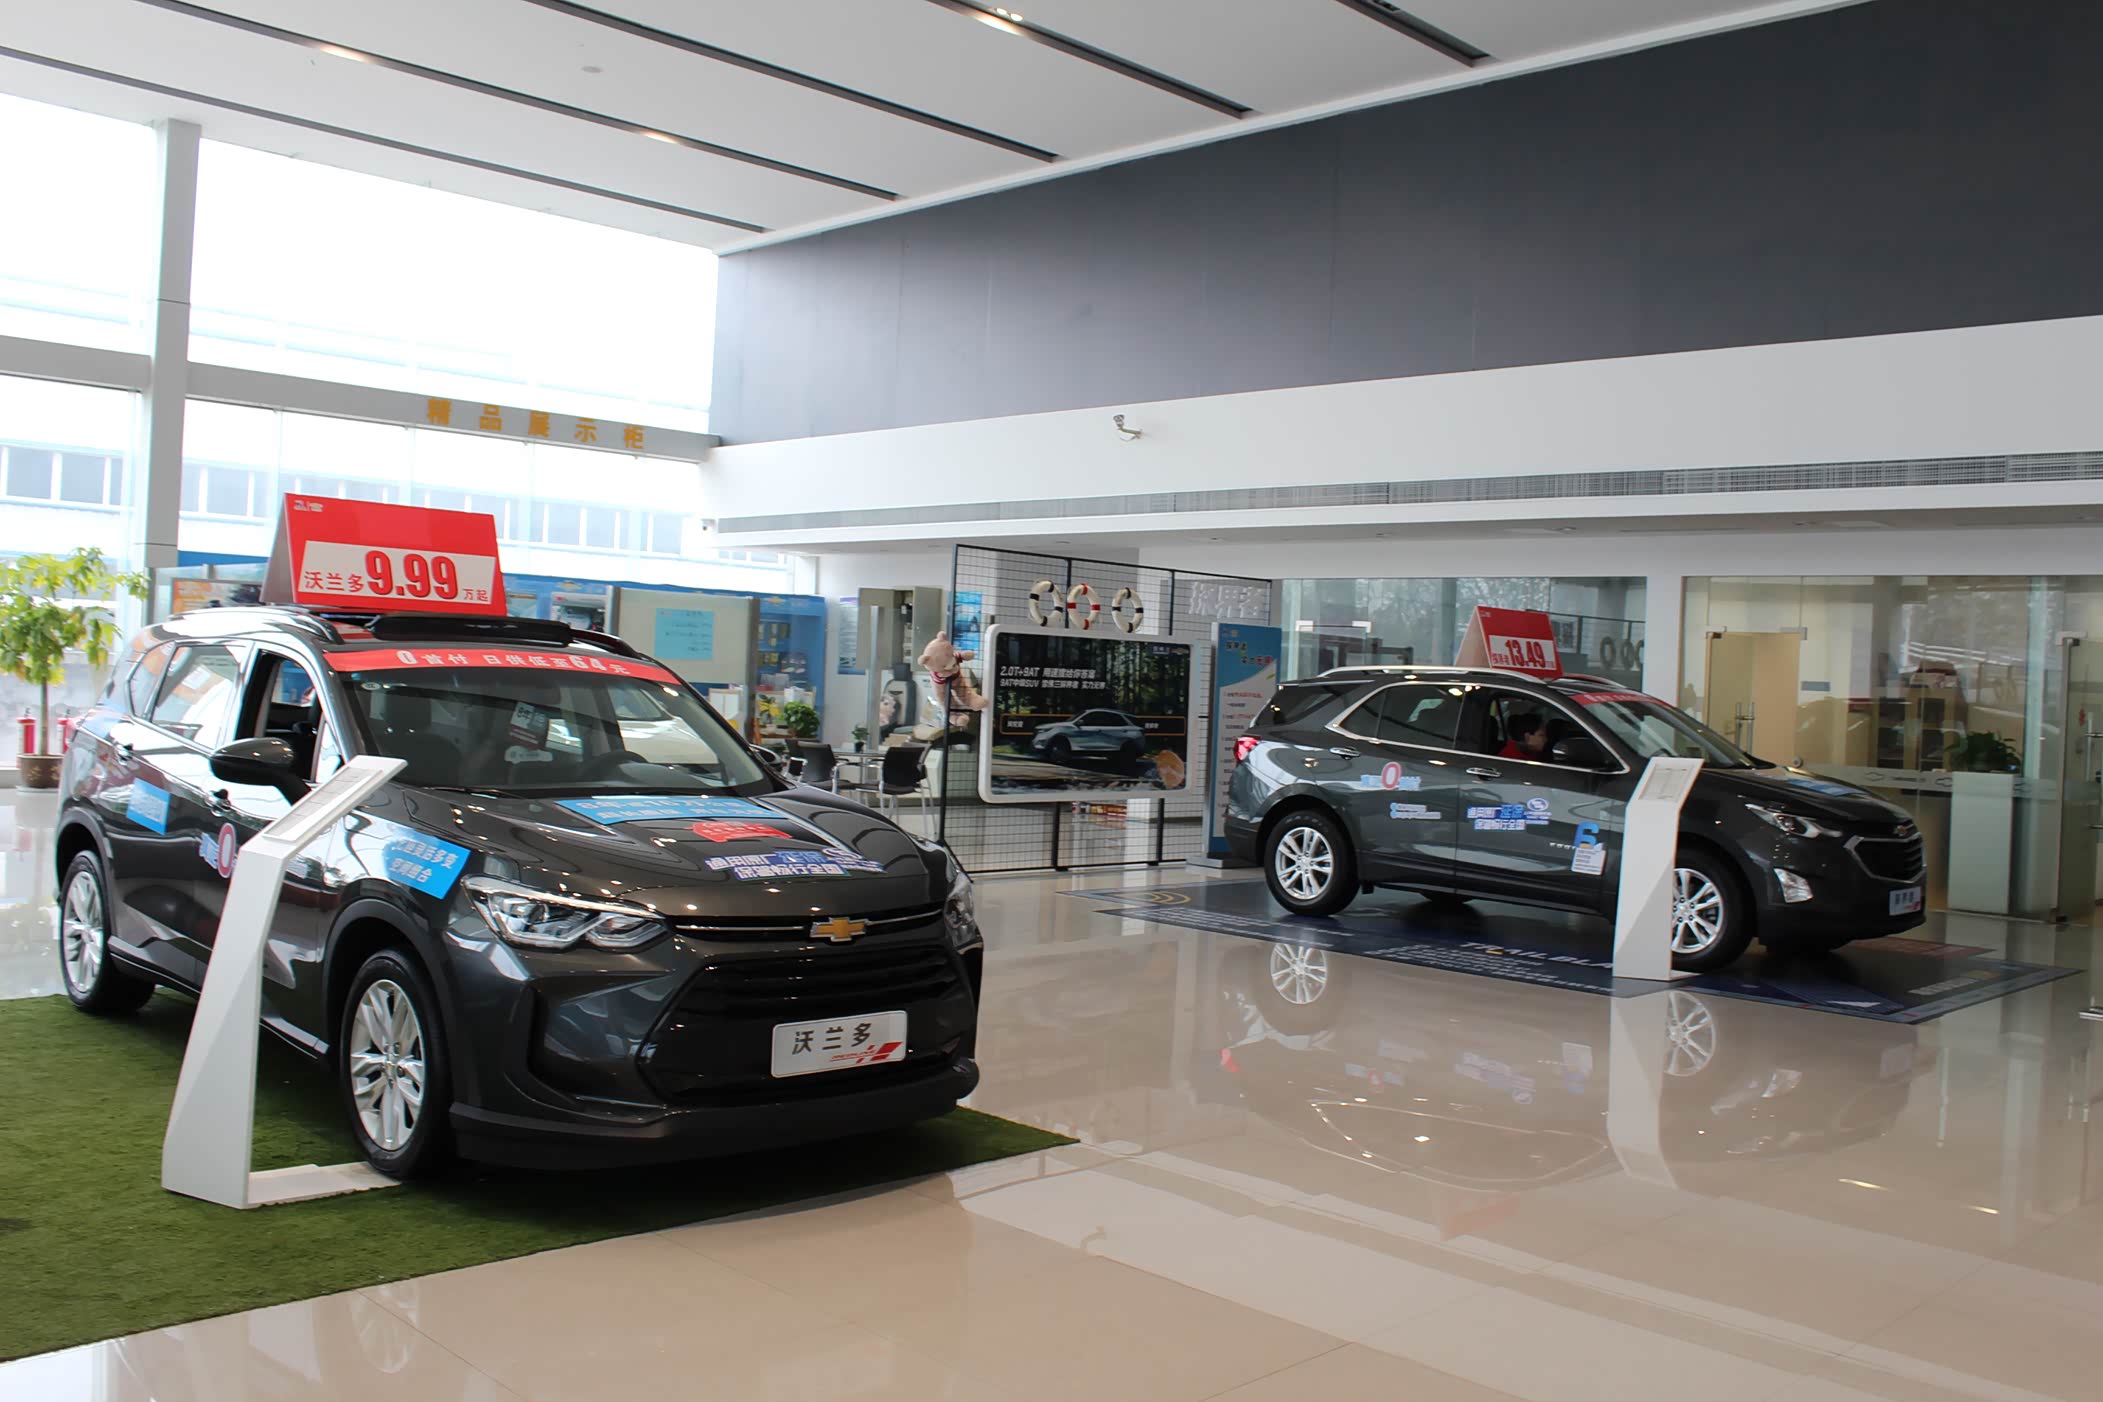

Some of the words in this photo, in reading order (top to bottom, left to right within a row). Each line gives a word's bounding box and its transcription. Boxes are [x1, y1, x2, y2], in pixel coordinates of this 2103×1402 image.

[426, 396, 647, 449] 精品展示柜
[303, 571, 364, 592] 沃兰多
[364, 550, 458, 599] 9.99
[463, 588, 489, 601] 万起
[397, 650, 468, 665] 0首付
[484, 653, 631, 675] 日供低至64元
[1505, 639, 1546, 668] 13.49
[999, 665, 1040, 677] 2.0T+9AT
[705, 850, 828, 870] 通用原厂延保
[792, 1023, 872, 1055] 沃兰多
